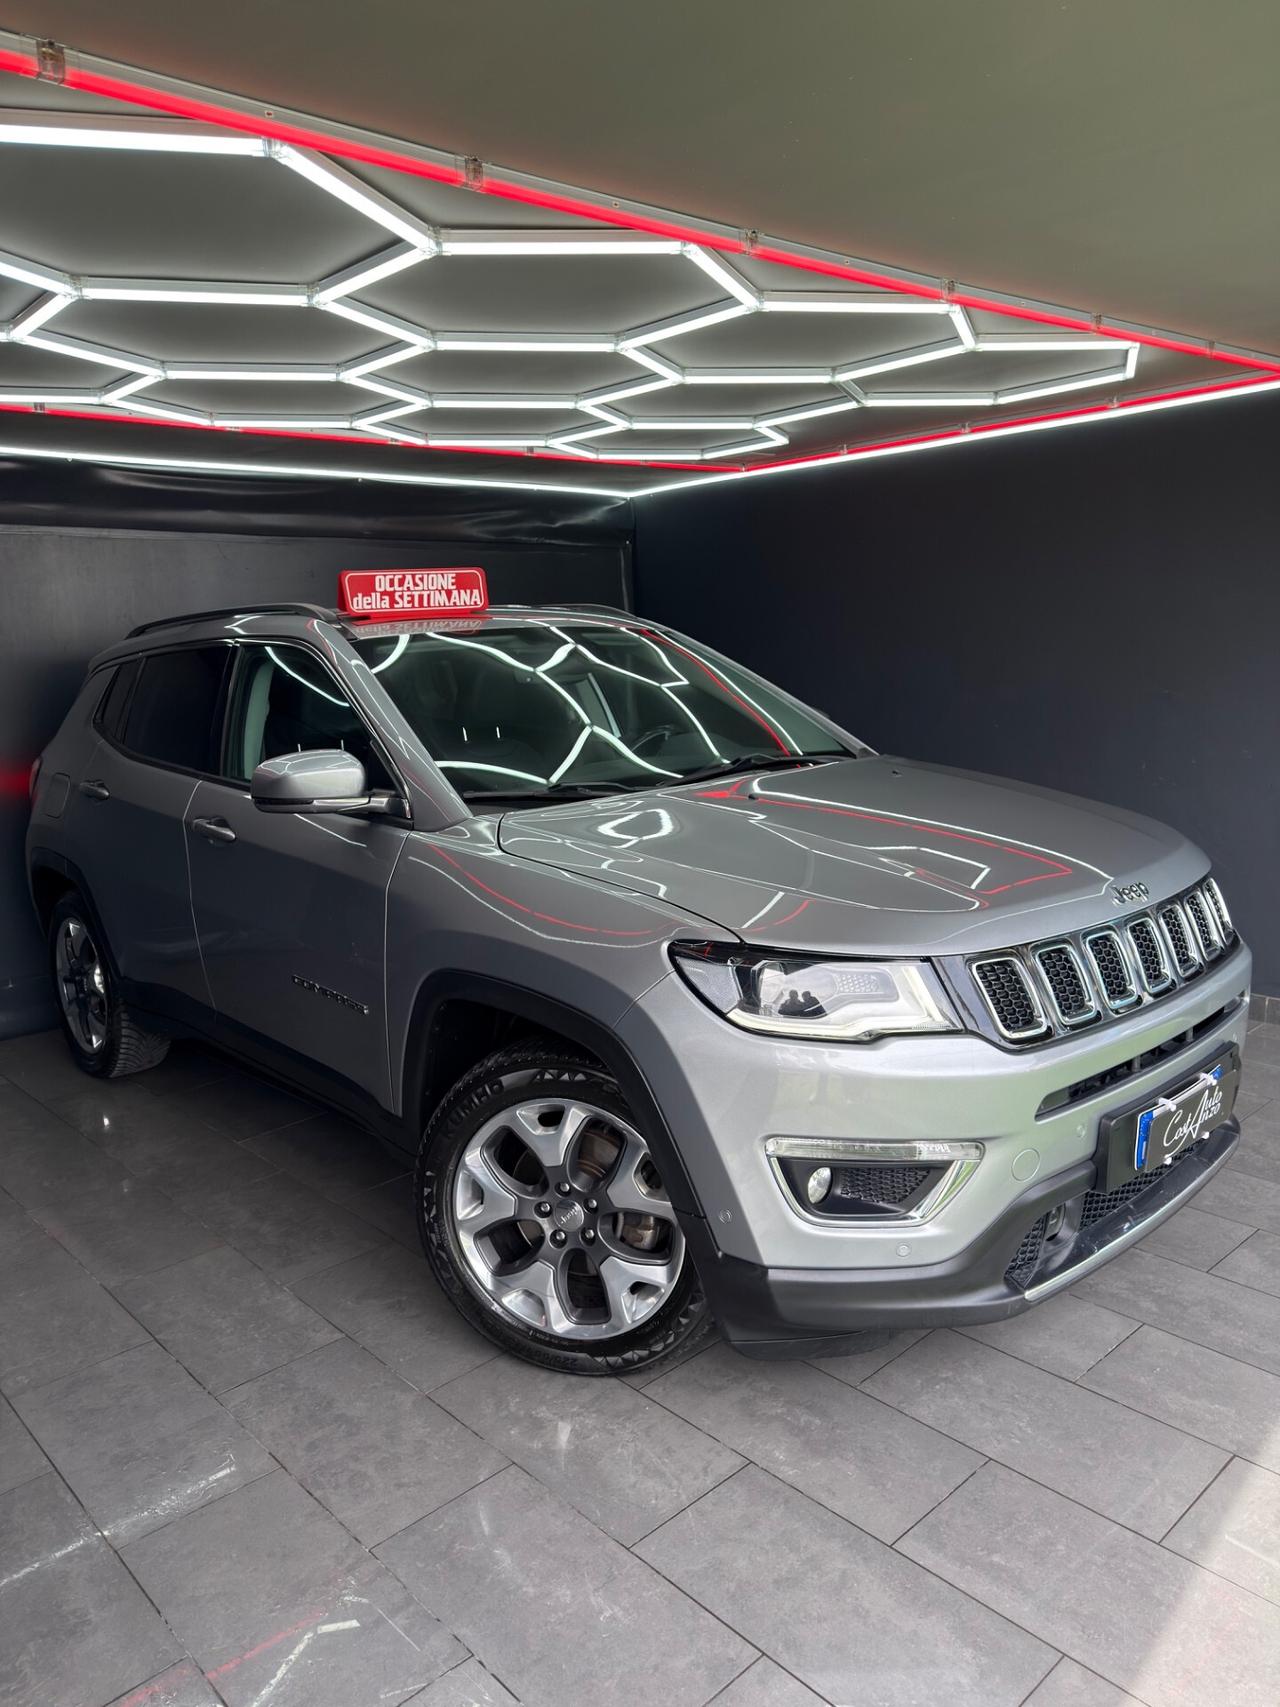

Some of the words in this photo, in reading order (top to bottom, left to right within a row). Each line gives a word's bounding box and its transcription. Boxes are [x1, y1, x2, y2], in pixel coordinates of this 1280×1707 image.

[375, 573, 456, 592] OCCASIONE
[353, 592, 390, 609] della
[394, 589, 481, 608] SETTIMANA
[1111, 882, 1149, 904] Jeep
[443, 1079, 504, 1134] UMHO
